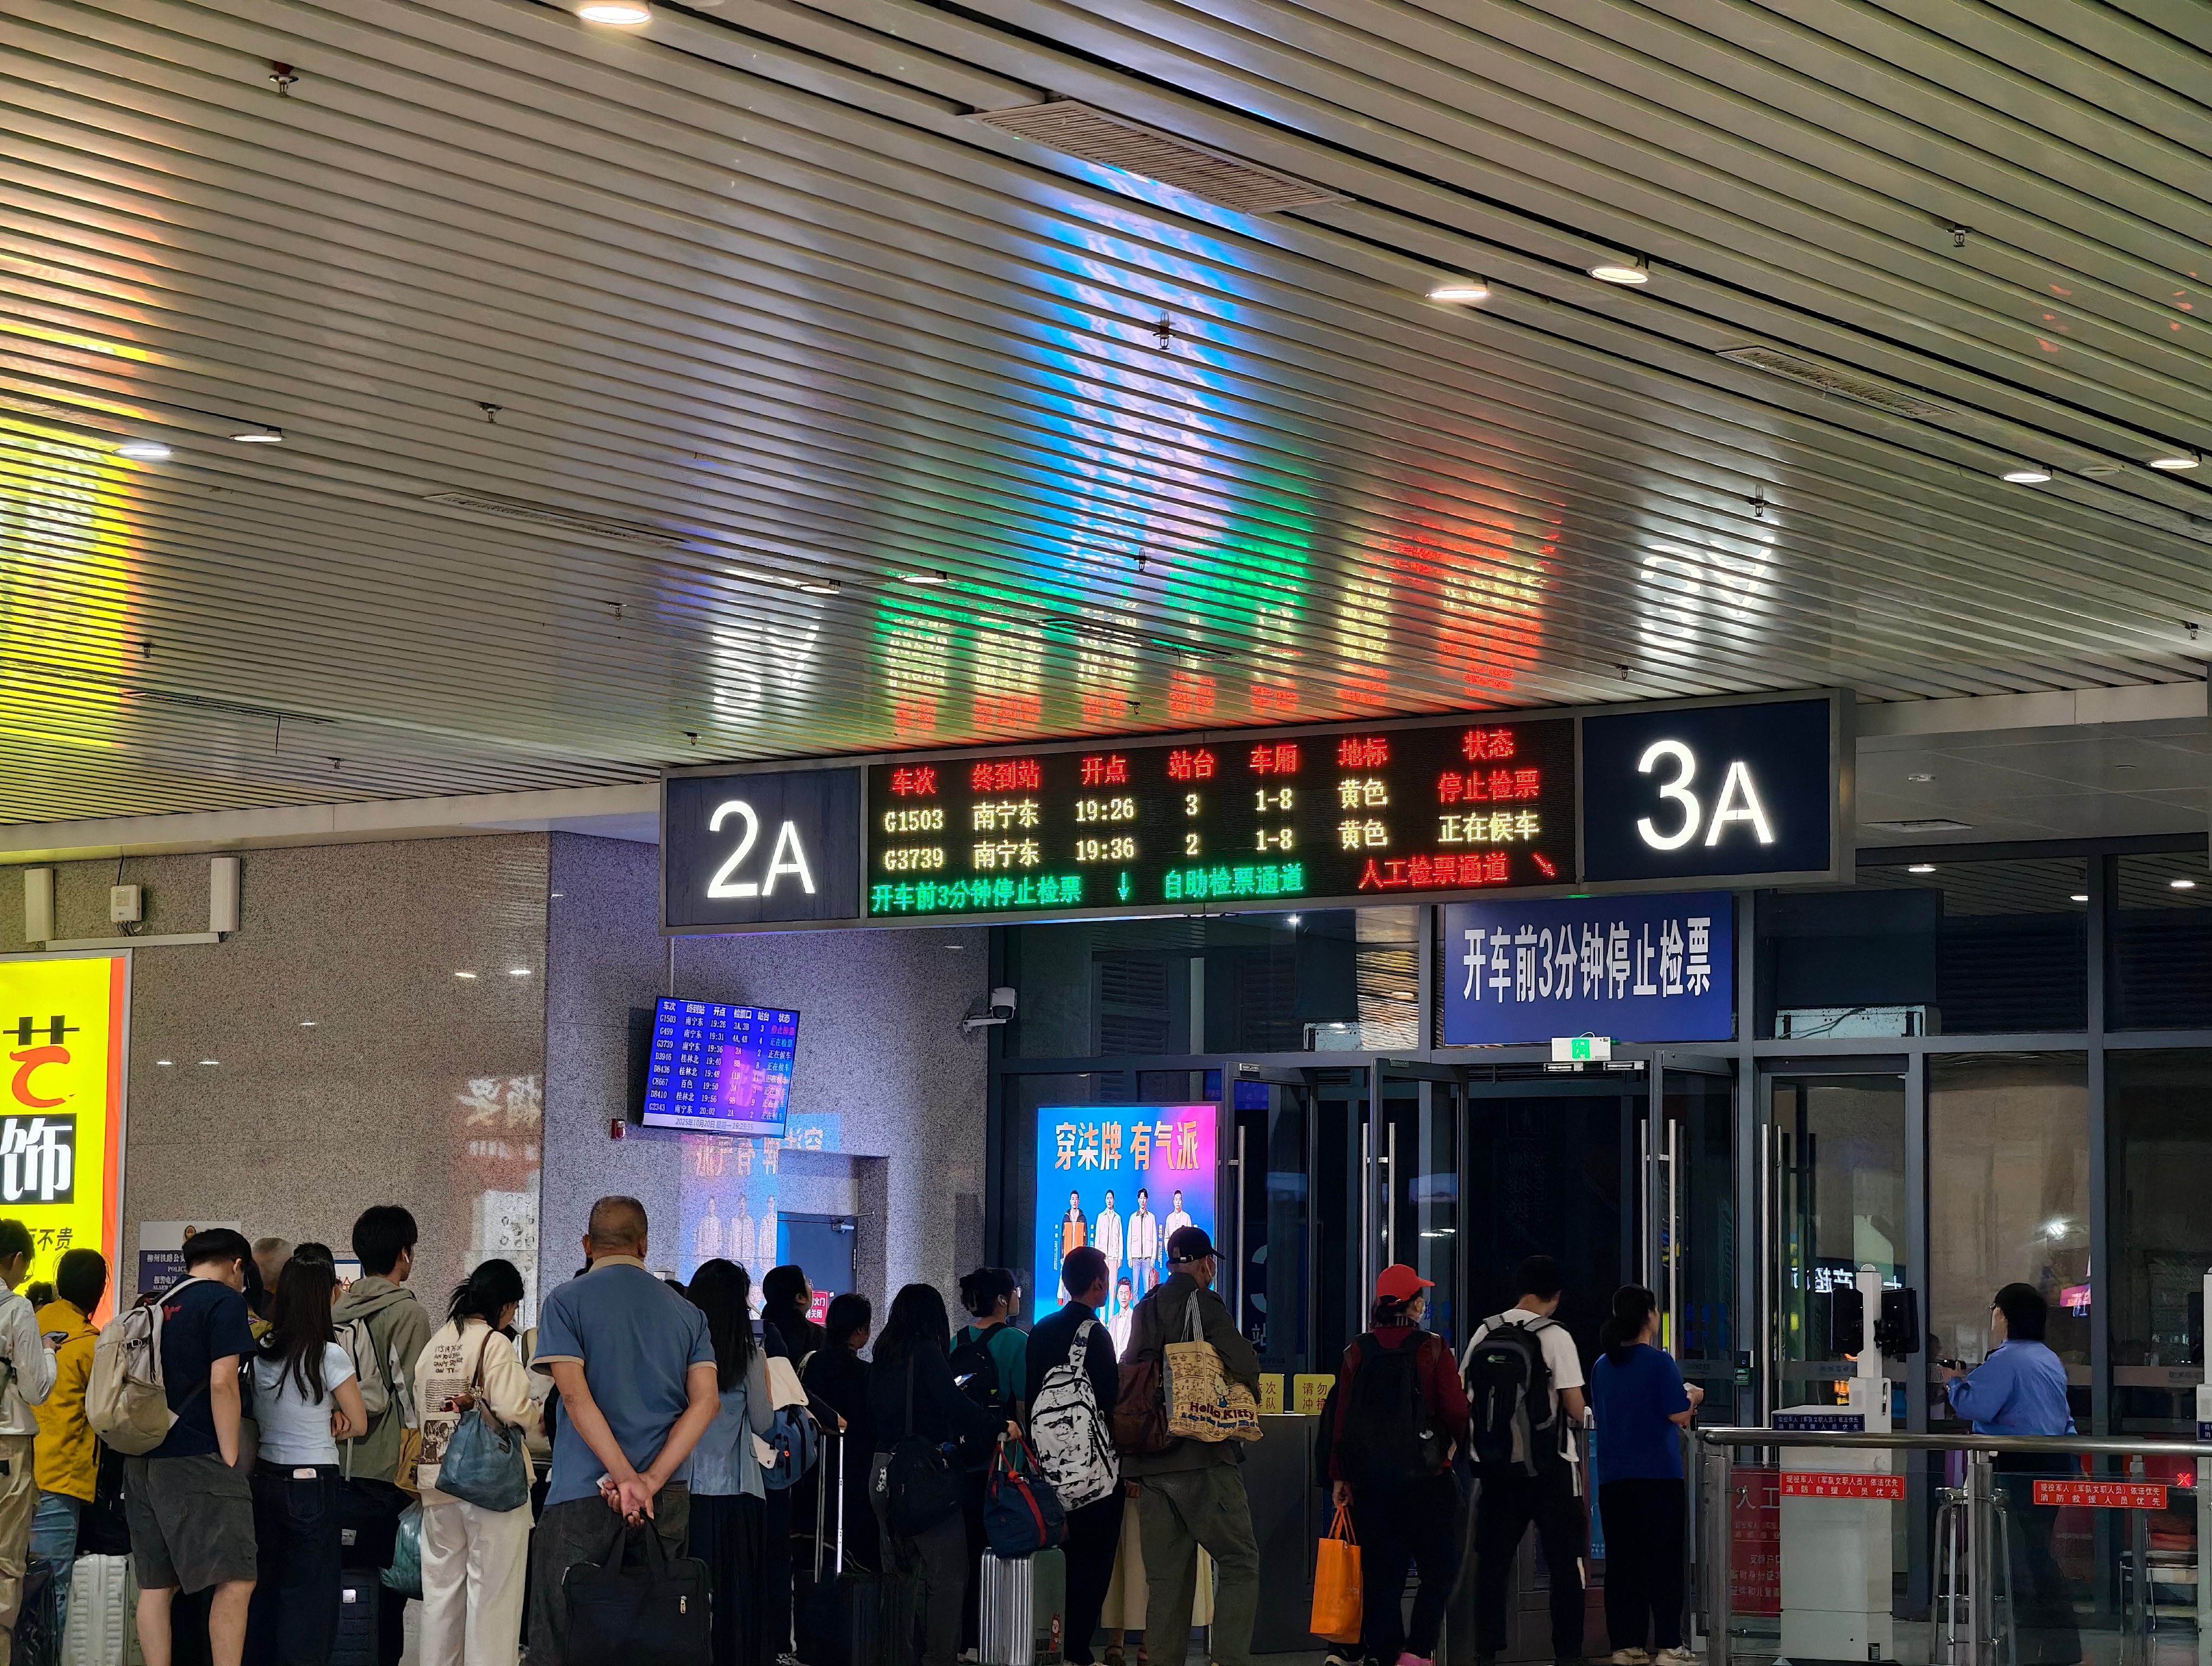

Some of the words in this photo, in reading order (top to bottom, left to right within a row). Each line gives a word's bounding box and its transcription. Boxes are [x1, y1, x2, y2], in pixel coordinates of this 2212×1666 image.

[892, 766, 936, 796] 车次
[972, 759, 1040, 792] 终到站
[1082, 754, 1128, 786] 开点
[1168, 749, 1214, 780] 站台
[1250, 745, 1298, 774] 车厢
[1338, 738, 1388, 768] 地标
[1462, 729, 1515, 761] 状态
[884, 808, 944, 833] G1503
[972, 798, 1040, 830] 南宁东
[1076, 798, 1134, 822] 19:26
[1186, 794, 1198, 816] 3
[1256, 788, 1293, 812] 1-8
[1338, 777, 1388, 810] 黄色
[1438, 768, 1540, 803] 停止检票
[1637, 740, 1773, 850] 3A
[708, 800, 815, 898] 2A
[884, 847, 944, 871] G3739
[973, 838, 1040, 870] 南宁东
[1076, 837, 1135, 861] 19:36
[1186, 833, 1198, 855] 2
[1256, 828, 1293, 850] 1-8
[1338, 818, 1388, 850] 黄色
[1438, 809, 1540, 844] 正在候车
[871, 875, 1082, 912] 开车前3分钟停止检票
[1165, 863, 1303, 899] 自助检票通道
[1359, 851, 1509, 889] 人工检票通道
[1463, 917, 1711, 1003] 开车前3分钟停止检票
[660, 1015, 676, 1023] G1503
[685, 1016, 703, 1026] 南宁东
[710, 1020, 726, 1028] 19:26
[663, 1001, 676, 1011] 车次
[686, 1003, 705, 1014] 终到站
[713, 1007, 726, 1016] 开点
[734, 1008, 751, 1019] 检票口
[757, 1011, 769, 1021] 站台
[778, 1013, 790, 1023] 状态
[660, 1027, 673, 1035] G499
[684, 1029, 702, 1039] 南宁东
[710, 1032, 724, 1040] 19:31
[657, 1040, 673, 1048] G3739
[683, 1041, 700, 1051] 南宁东
[708, 1045, 723, 1053] 19:36
[768, 1050, 791, 1060] 正在候车
[654, 1065, 670, 1073] D8436
[679, 1067, 697, 1076] 桂林北
[705, 1069, 720, 1078] 19:48
[655, 1053, 672, 1061] D3946
[681, 1054, 698, 1063] 桂林北
[706, 1057, 722, 1065] 19:40
[767, 1062, 789, 1072] 正在候车
[652, 1078, 668, 1086] C8667
[681, 1079, 693, 1088] 百色
[703, 1082, 718, 1090] 19:50
[651, 1090, 667, 1098] D8410
[676, 1092, 694, 1101] 桂林北
[702, 1094, 717, 1103] 19:56
[649, 1103, 665, 1111] G2343
[674, 1104, 693, 1114] 南宁东
[699, 1107, 716, 1115] 20:02
[676, 1118, 715, 1129] 2025年10月20日
[732, 1123, 753, 1131] 19:25:35
[1055, 1121, 1122, 1170] 穿柒牌
[1130, 1120, 1200, 1170] 有气派
[1303, 1382, 1327, 1395] 请勿
[1190, 1401, 1220, 1418] Hello
[1224, 1409, 1254, 1420] Kitty
